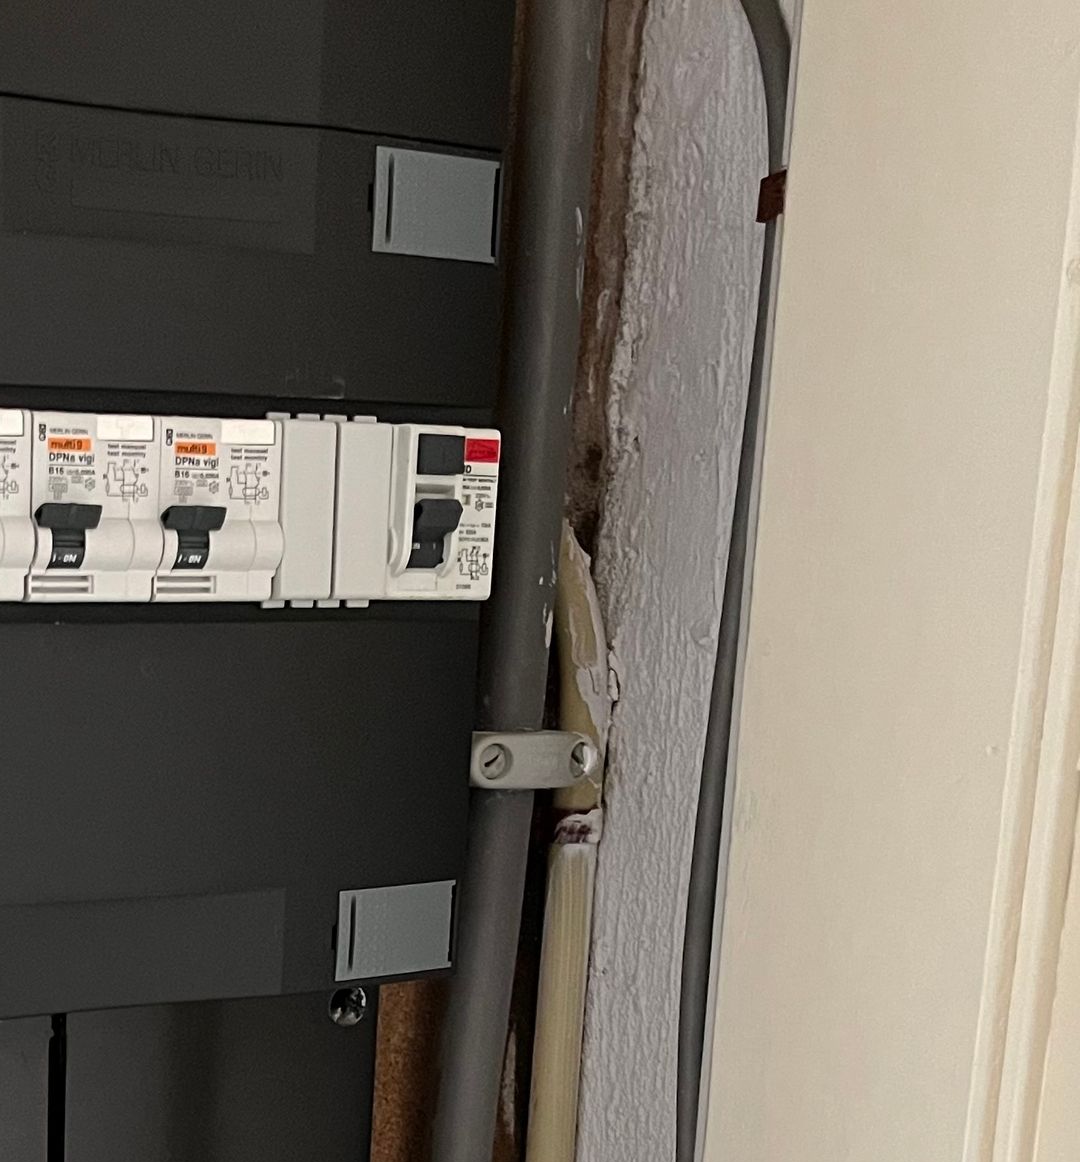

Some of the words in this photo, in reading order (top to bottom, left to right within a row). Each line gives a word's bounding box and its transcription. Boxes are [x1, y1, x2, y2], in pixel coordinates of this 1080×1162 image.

[49, 453, 75, 463] DPNa
[79, 454, 95, 465] vigi
[175, 456, 200, 466] DPNa
[204, 457, 219, 469] vigi
